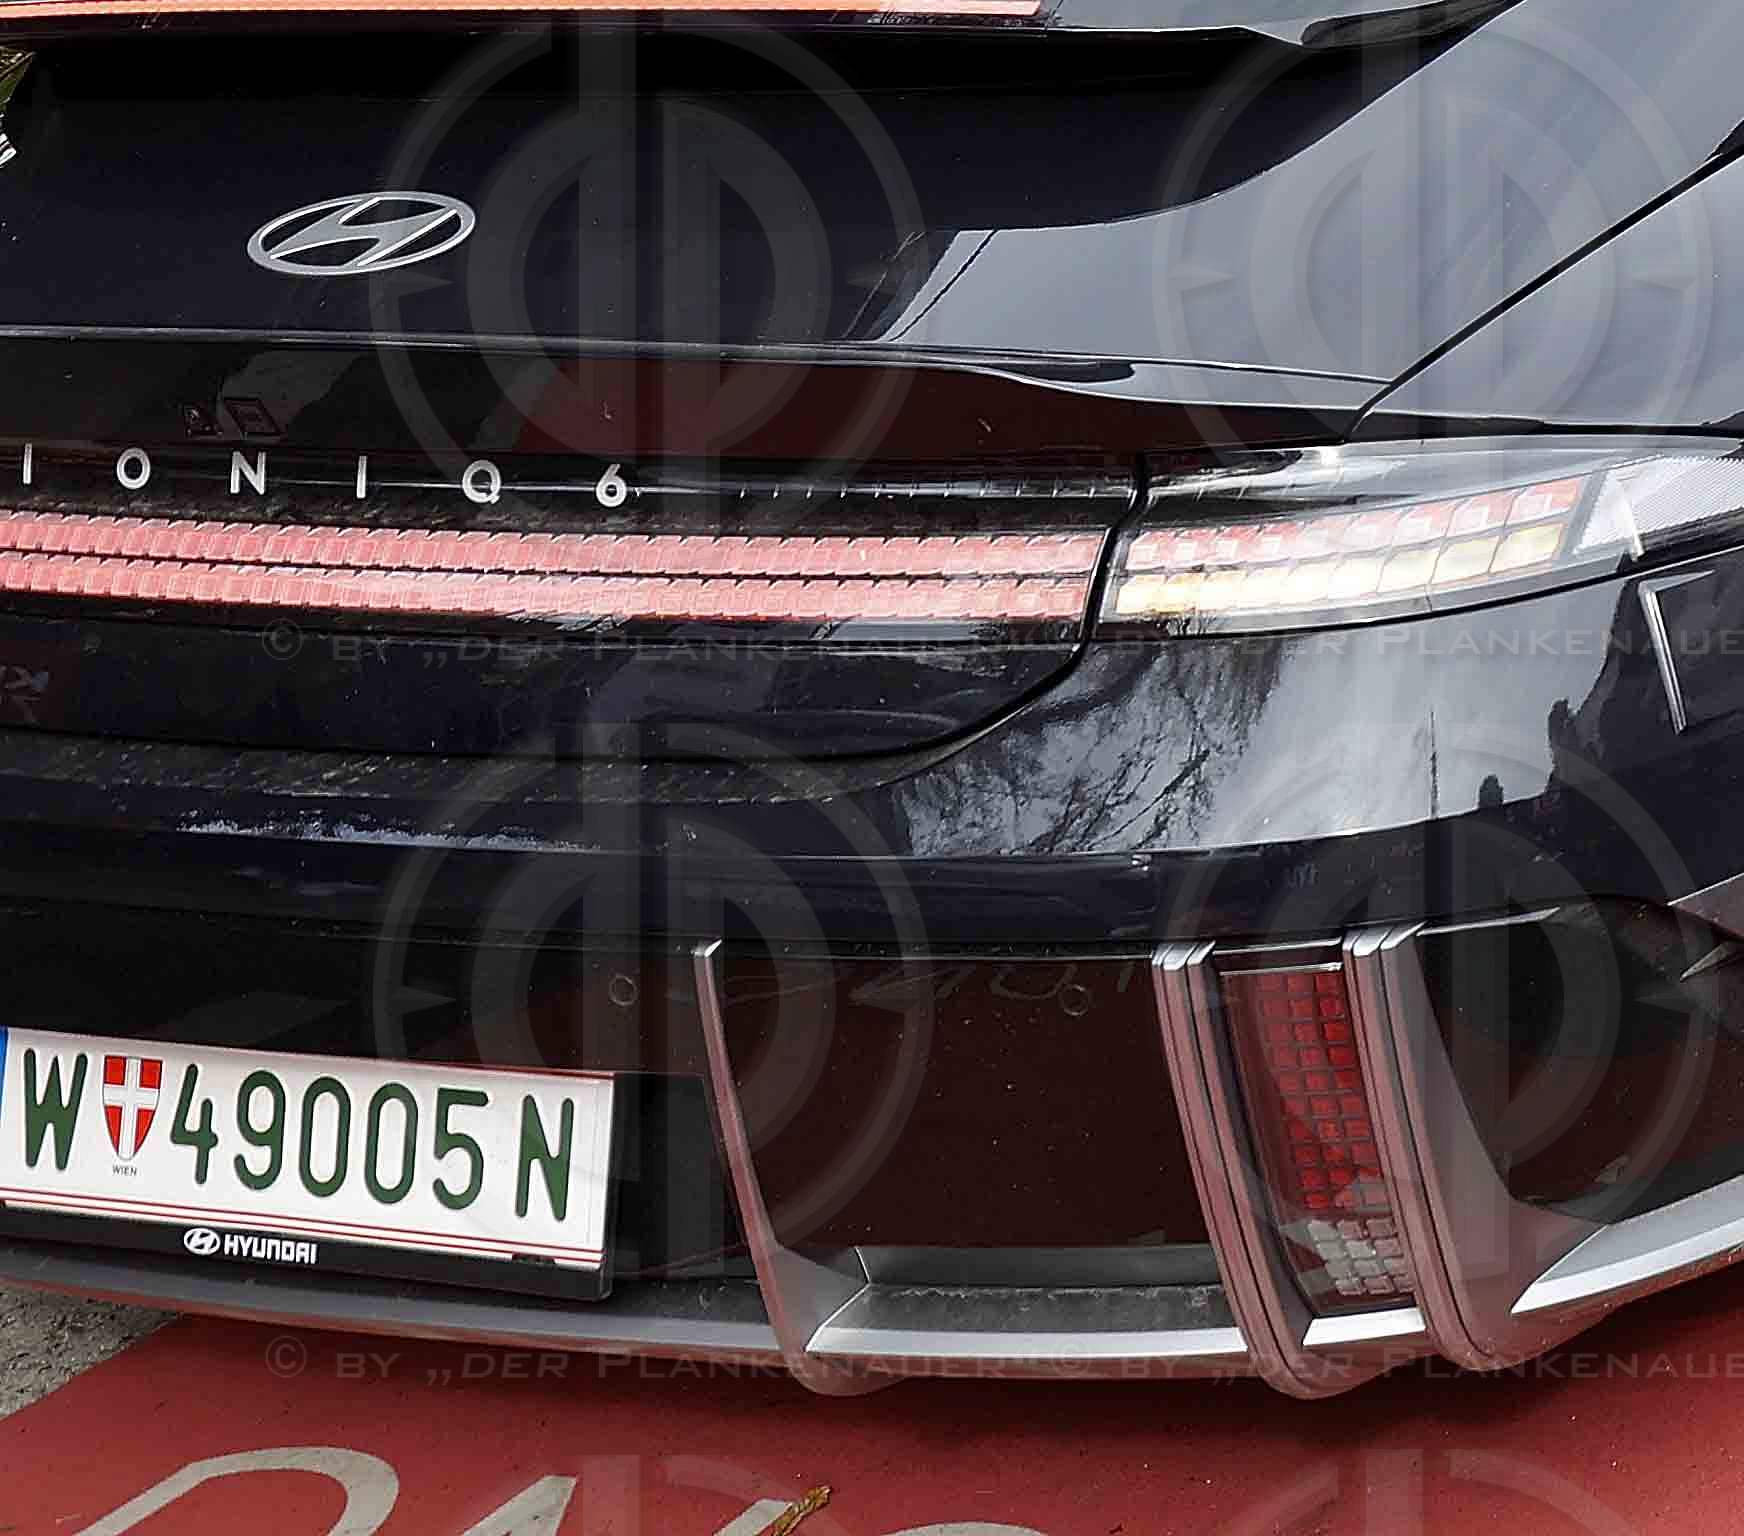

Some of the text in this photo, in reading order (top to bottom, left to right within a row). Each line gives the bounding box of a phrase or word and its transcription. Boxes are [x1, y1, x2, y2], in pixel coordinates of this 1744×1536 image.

[22, 456, 504, 505] IONIQ
[111, 1165, 138, 1178] WIEN
[223, 1234, 319, 1266] HYUNDAI
